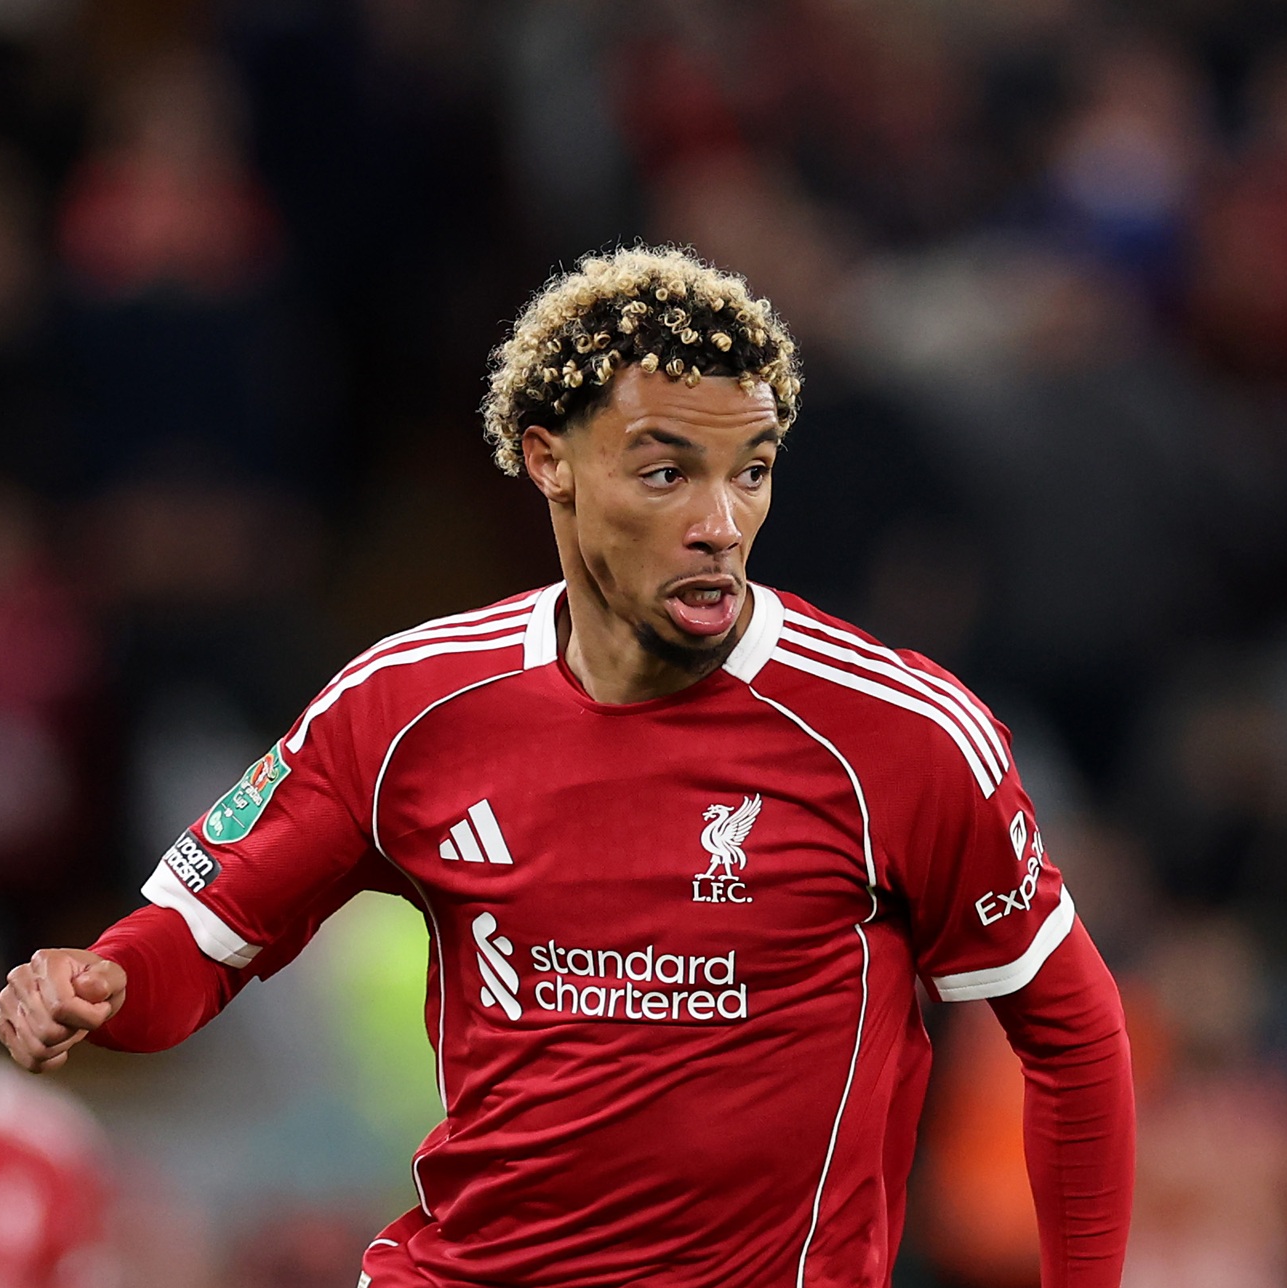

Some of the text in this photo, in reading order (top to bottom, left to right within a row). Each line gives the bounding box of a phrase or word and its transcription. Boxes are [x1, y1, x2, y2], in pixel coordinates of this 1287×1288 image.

[176, 836, 214, 876] room
[692, 881, 753, 903] L.F.C.
[531, 939, 736, 986] standard
[534, 975, 748, 1021] chartered
